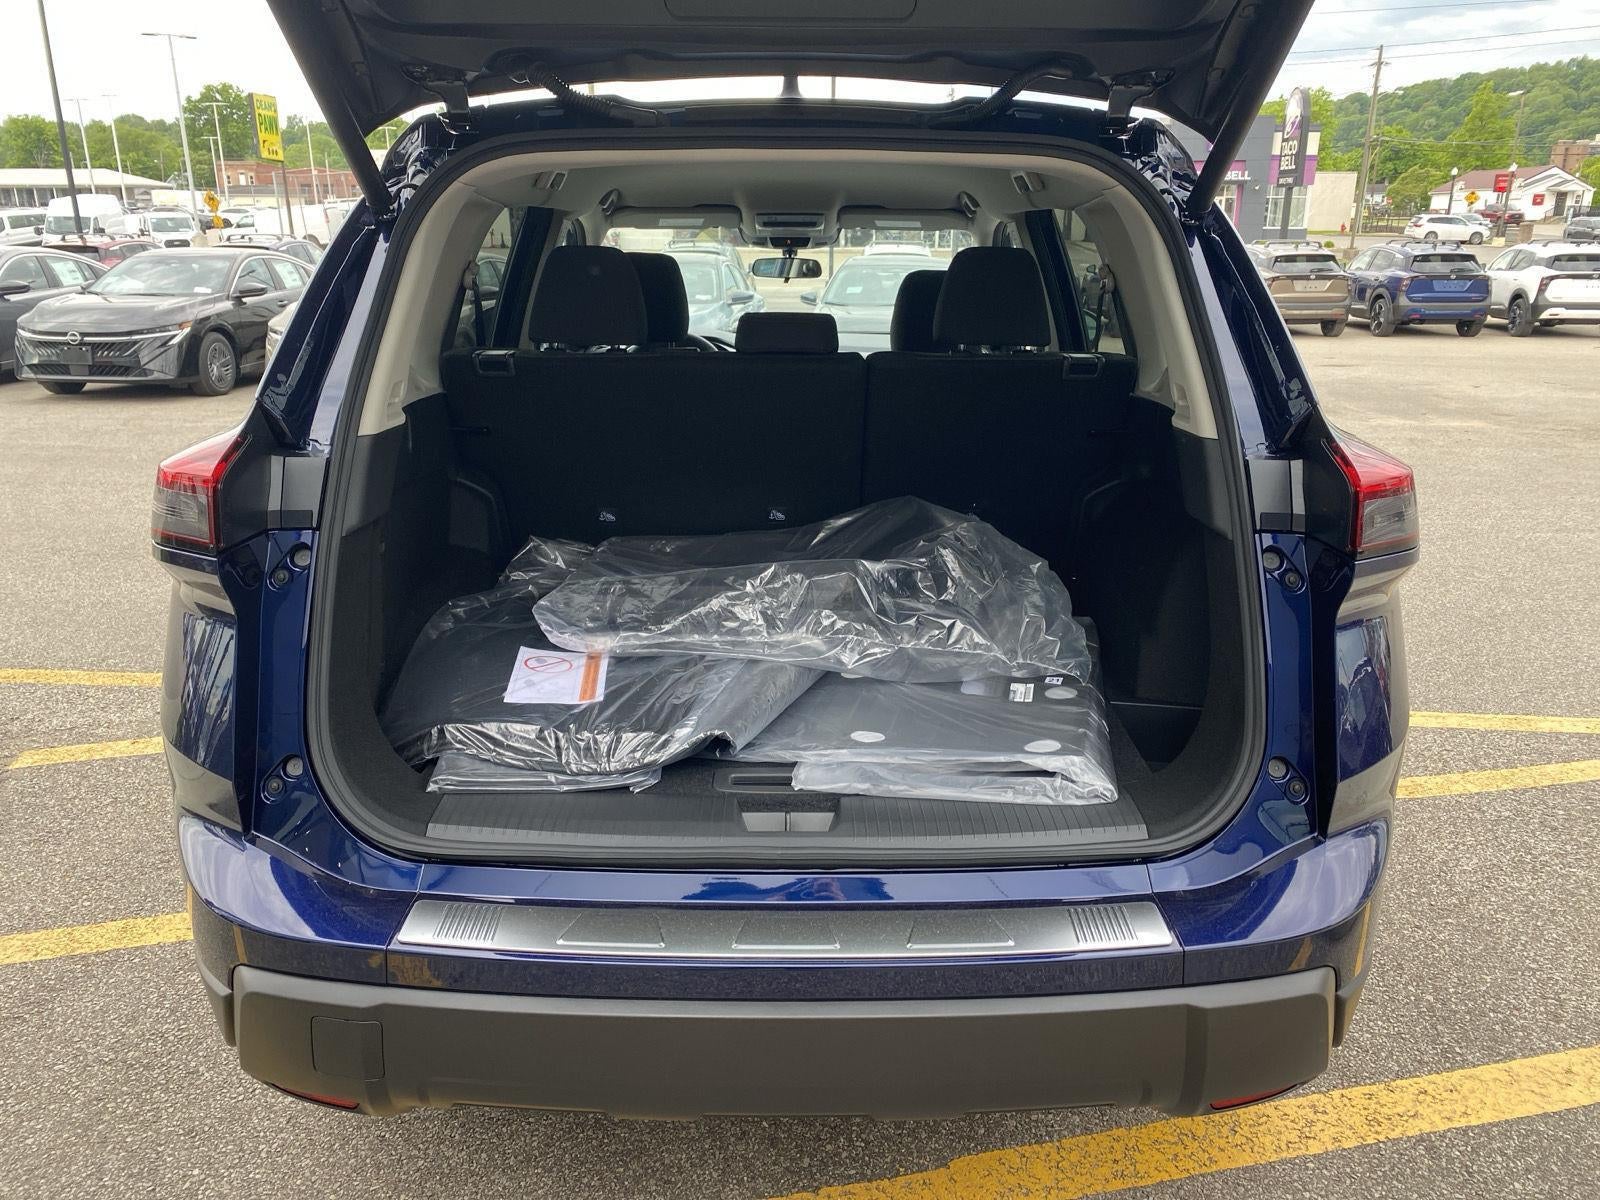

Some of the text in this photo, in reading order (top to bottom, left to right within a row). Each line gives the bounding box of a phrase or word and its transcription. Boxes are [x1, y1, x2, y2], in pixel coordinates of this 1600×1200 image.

[1281, 140, 1298, 156] TACO
[1280, 156, 1296, 171] BELL
[1224, 171, 1251, 180] BELL
